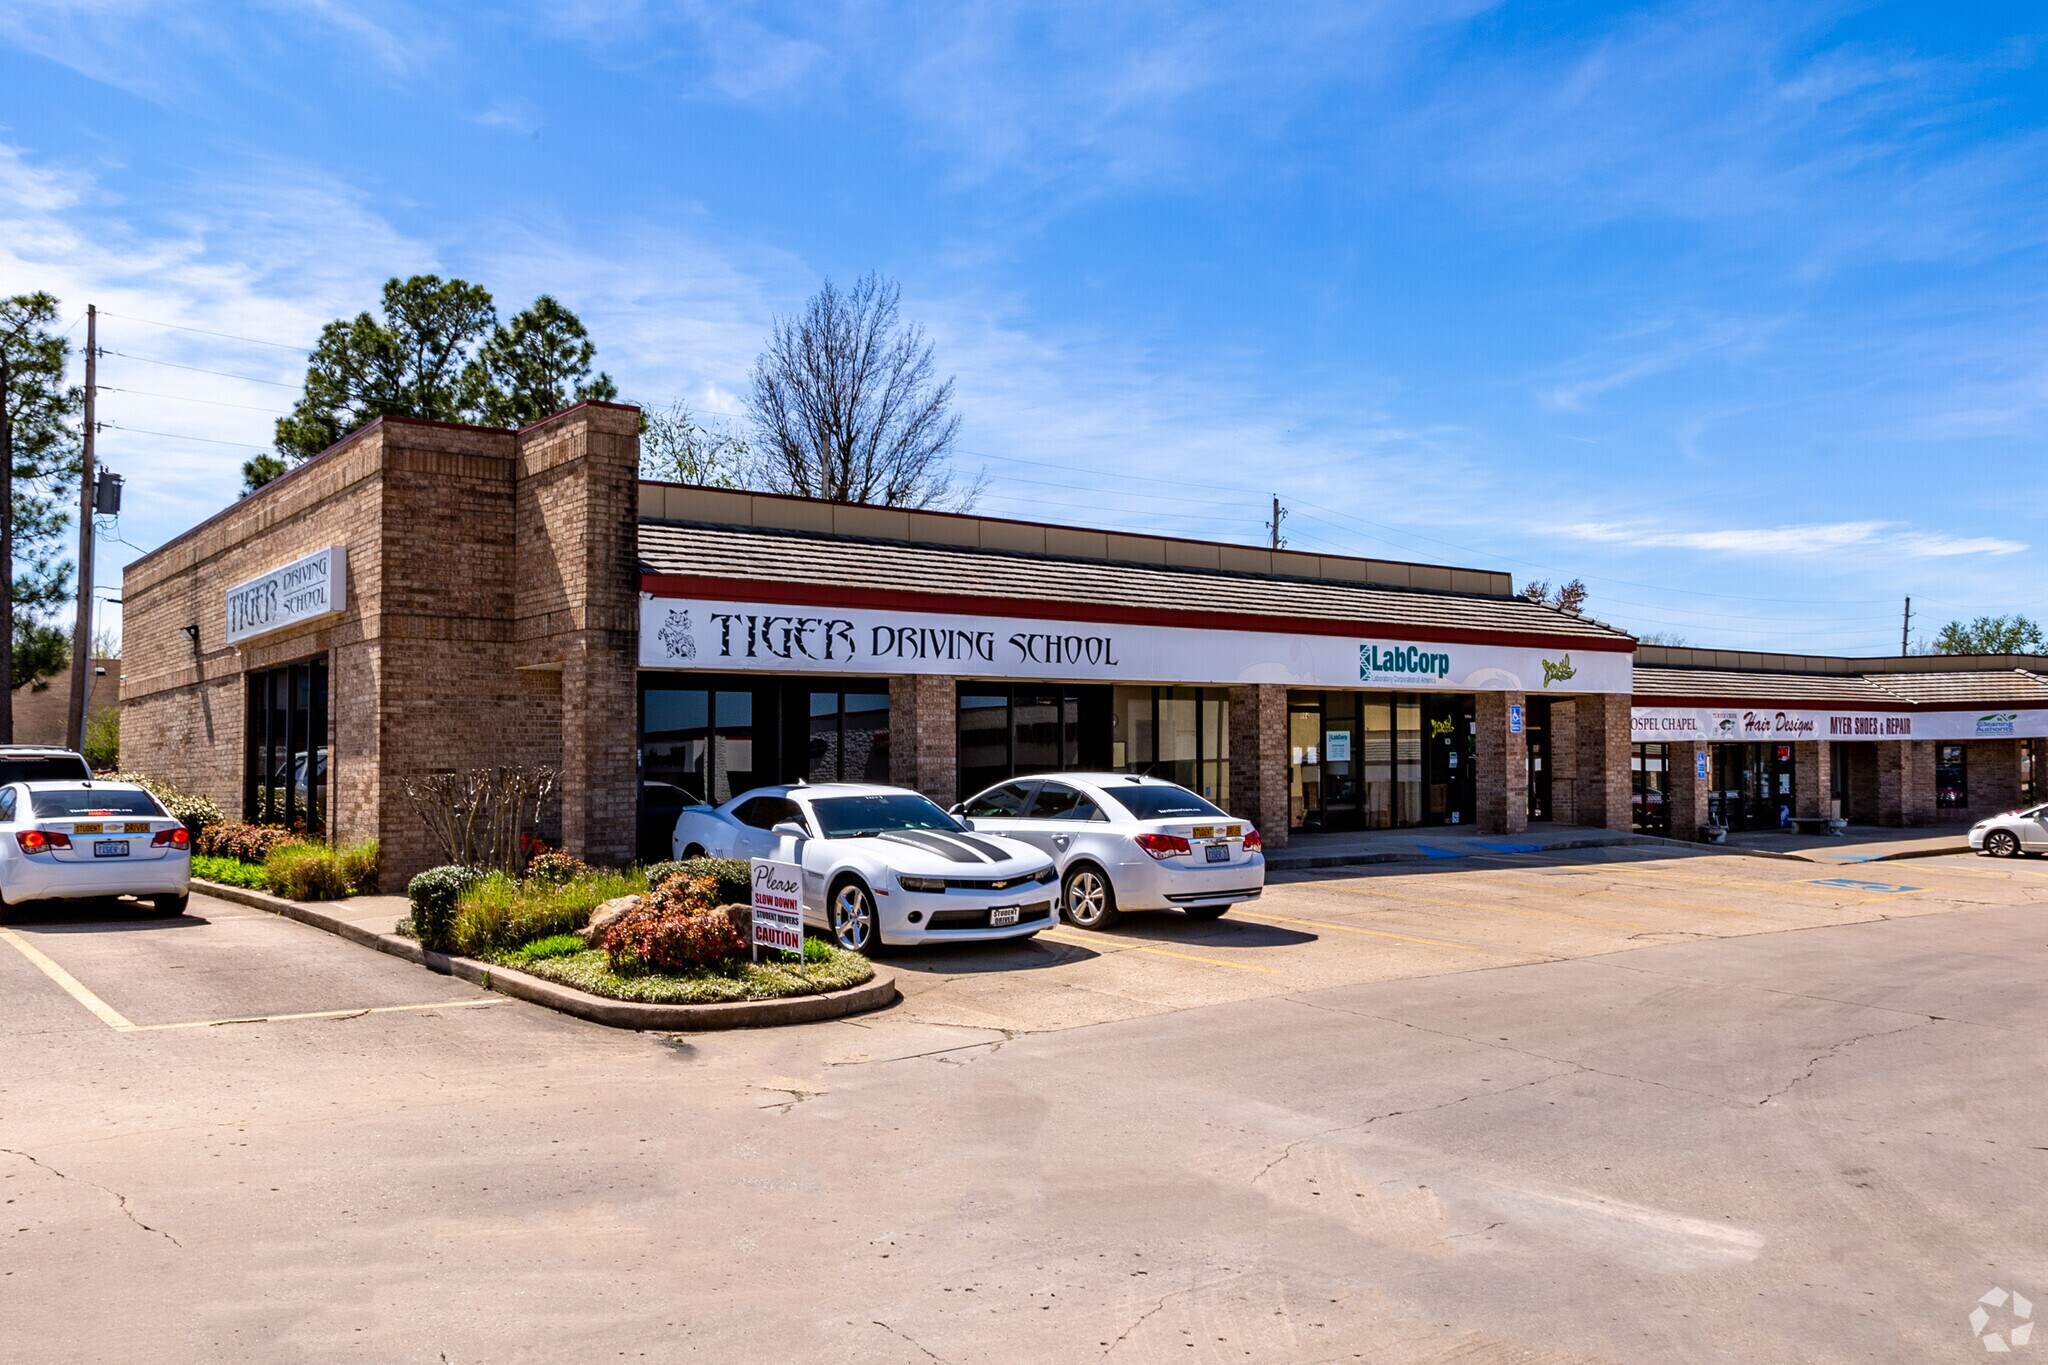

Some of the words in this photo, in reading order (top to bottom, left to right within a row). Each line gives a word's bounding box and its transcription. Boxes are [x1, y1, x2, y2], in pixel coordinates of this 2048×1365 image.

[283, 557, 327, 590] DRIVING
[229, 579, 278, 633] TIGER
[283, 587, 327, 615] SCHOOL
[710, 613, 856, 663] TIGER
[871, 625, 995, 661] DRIVING
[1008, 632, 1119, 666] SCHOOL
[1372, 645, 1450, 679] LabCorp
[1631, 717, 1660, 731] OSPEL
[1661, 717, 1698, 731] CHAPEL
[1743, 711, 1771, 731] Hair
[1775, 711, 1814, 738] Designs
[1830, 716, 1852, 735] MYER
[1854, 716, 1878, 735] SHOES
[1880, 722, 1884, 735] &
[1886, 717, 1911, 735] REPAIR
[75, 824, 102, 833] STUDENT
[125, 823, 149, 832] DRIVER
[754, 865, 799, 893] Please
[755, 893, 773, 906] SLOW
[775, 896, 798, 910] DOWN!
[993, 908, 1018, 917] STUDENT
[756, 910, 777, 921] STUDENT
[777, 914, 799, 925] DRIVERS
[995, 916, 1015, 924] DRIVER
[755, 926, 799, 948] CAUTION
